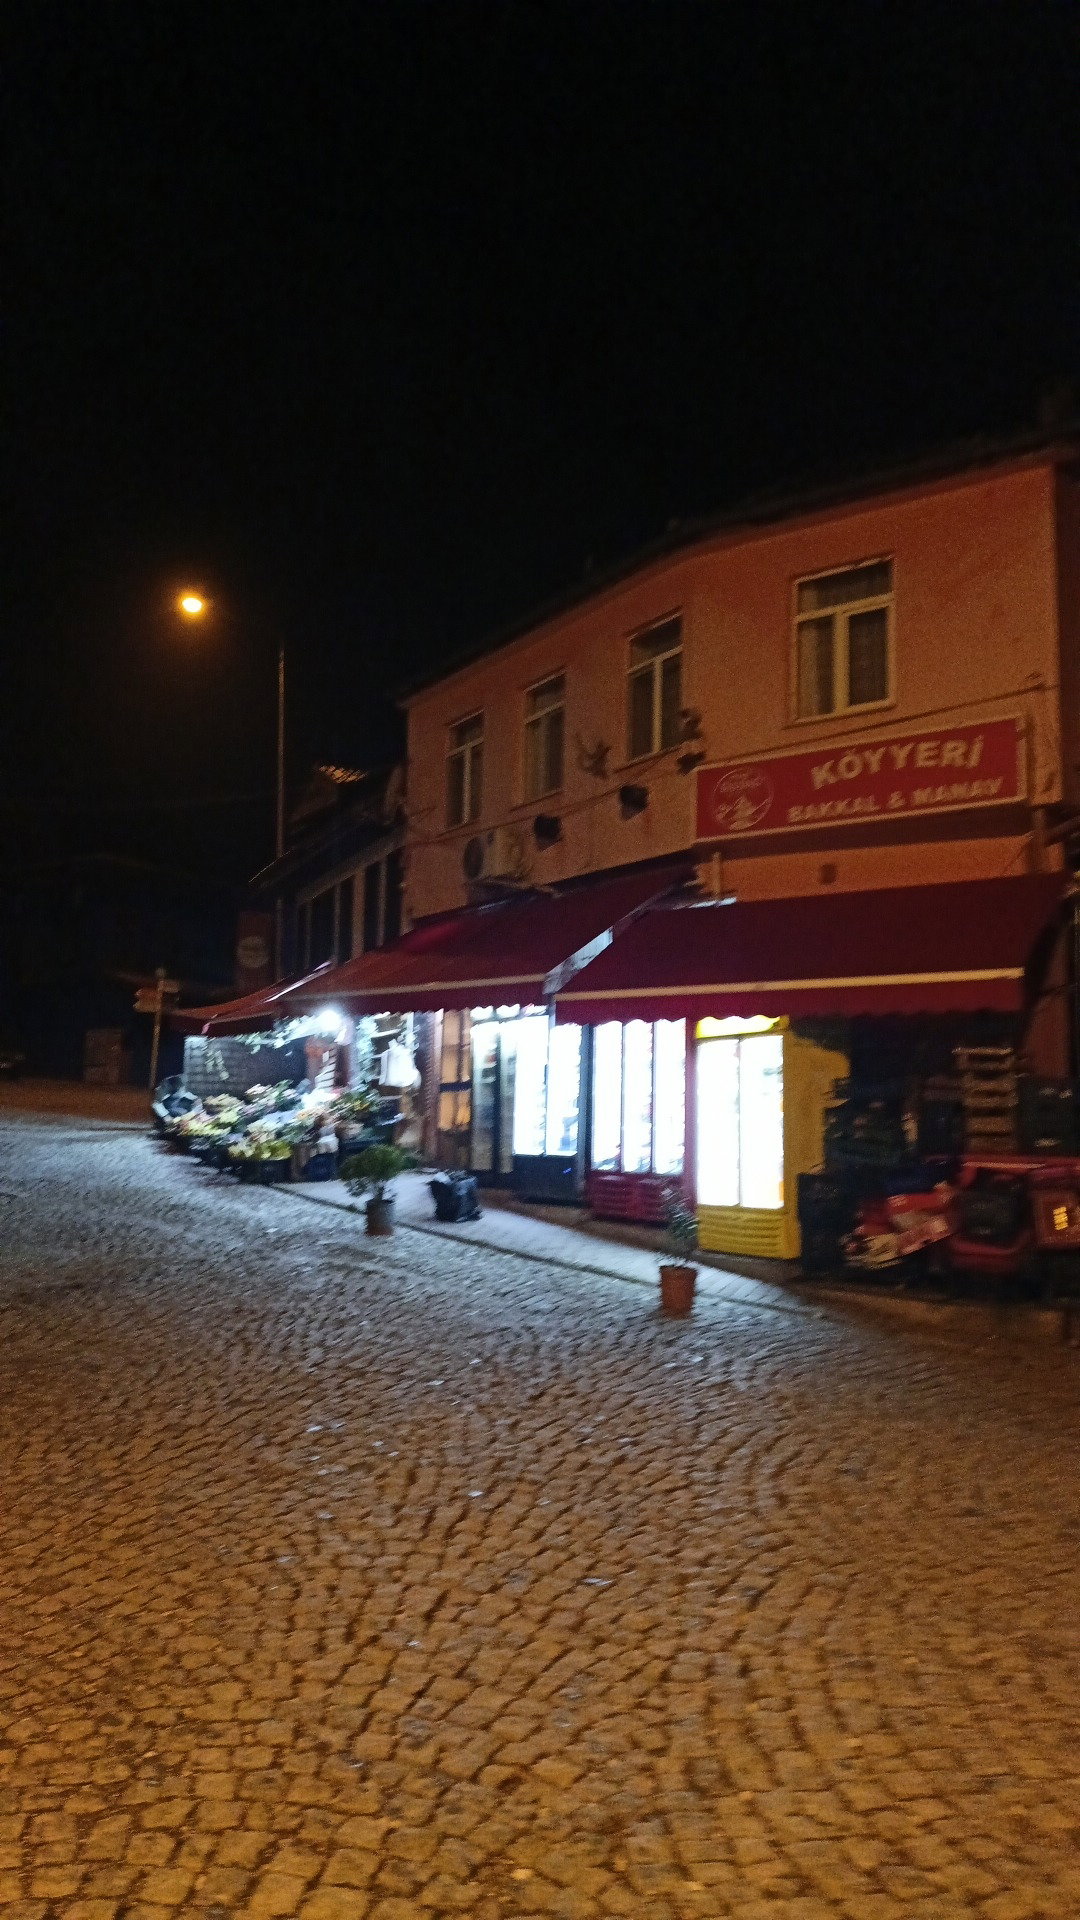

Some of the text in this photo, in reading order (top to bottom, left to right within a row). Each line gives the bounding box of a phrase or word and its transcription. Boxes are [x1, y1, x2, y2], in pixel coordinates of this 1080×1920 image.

[811, 734, 984, 789] KÖYYERİ
[787, 777, 1003, 823] BAKKAL & MANAV
